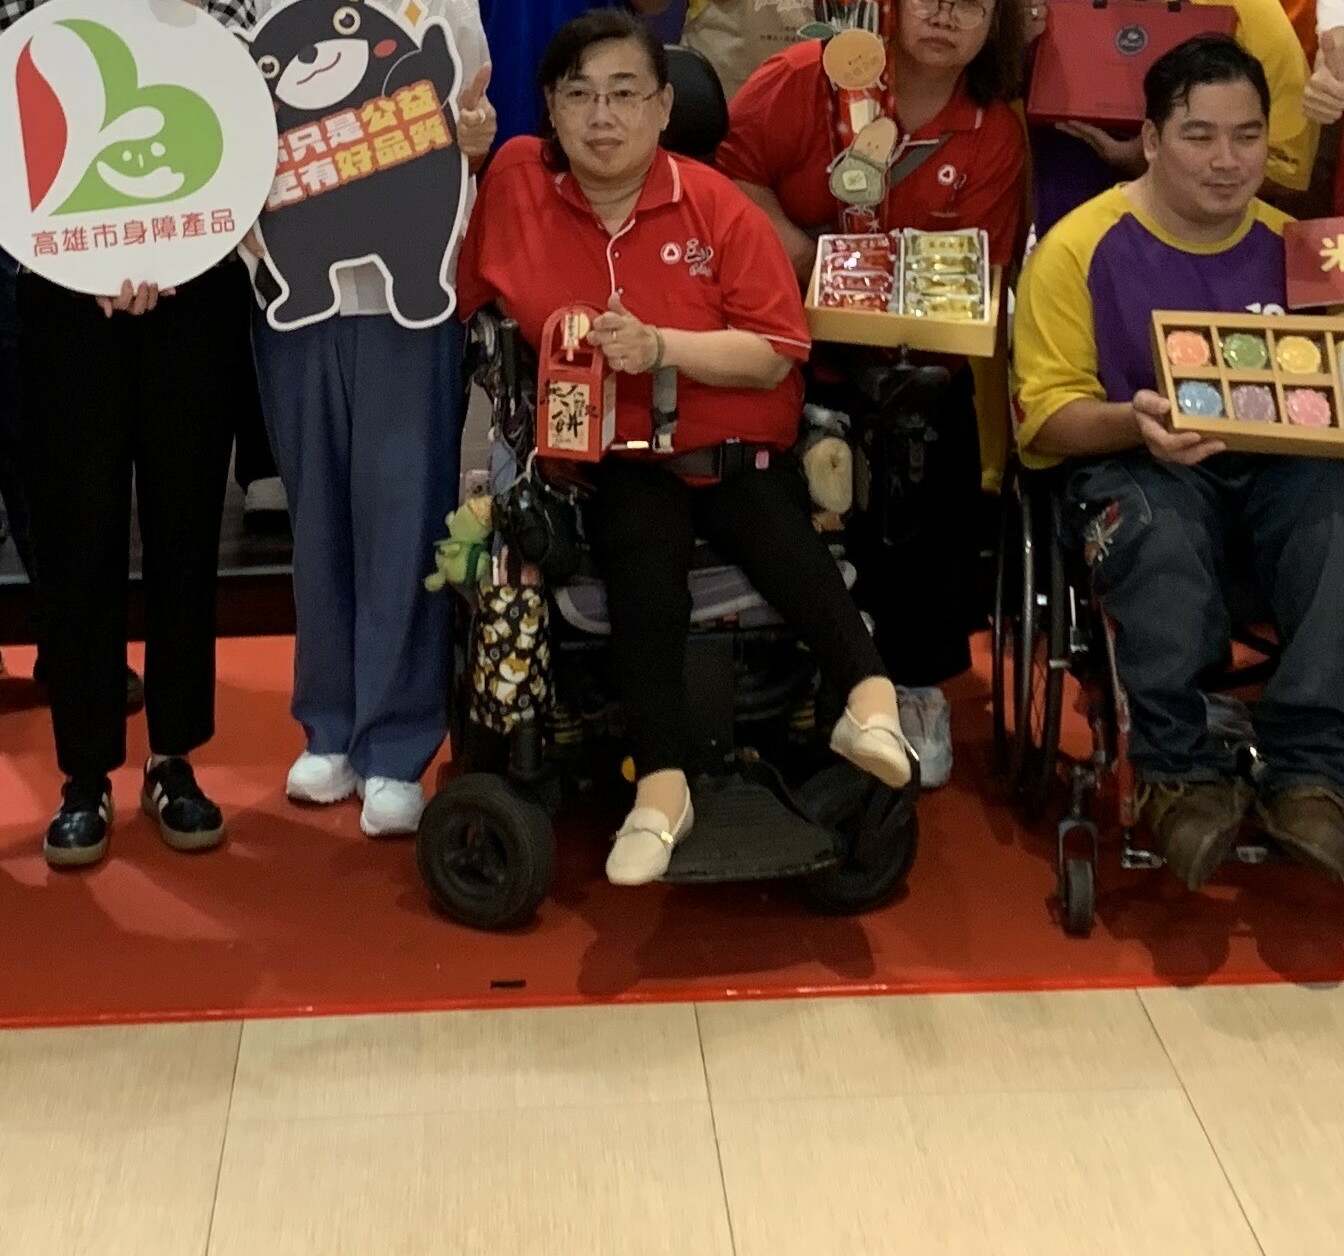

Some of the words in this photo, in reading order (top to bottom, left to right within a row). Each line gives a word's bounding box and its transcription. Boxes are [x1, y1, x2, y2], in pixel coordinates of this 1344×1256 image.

[31, 208, 236, 258] 高雄市身障產品
